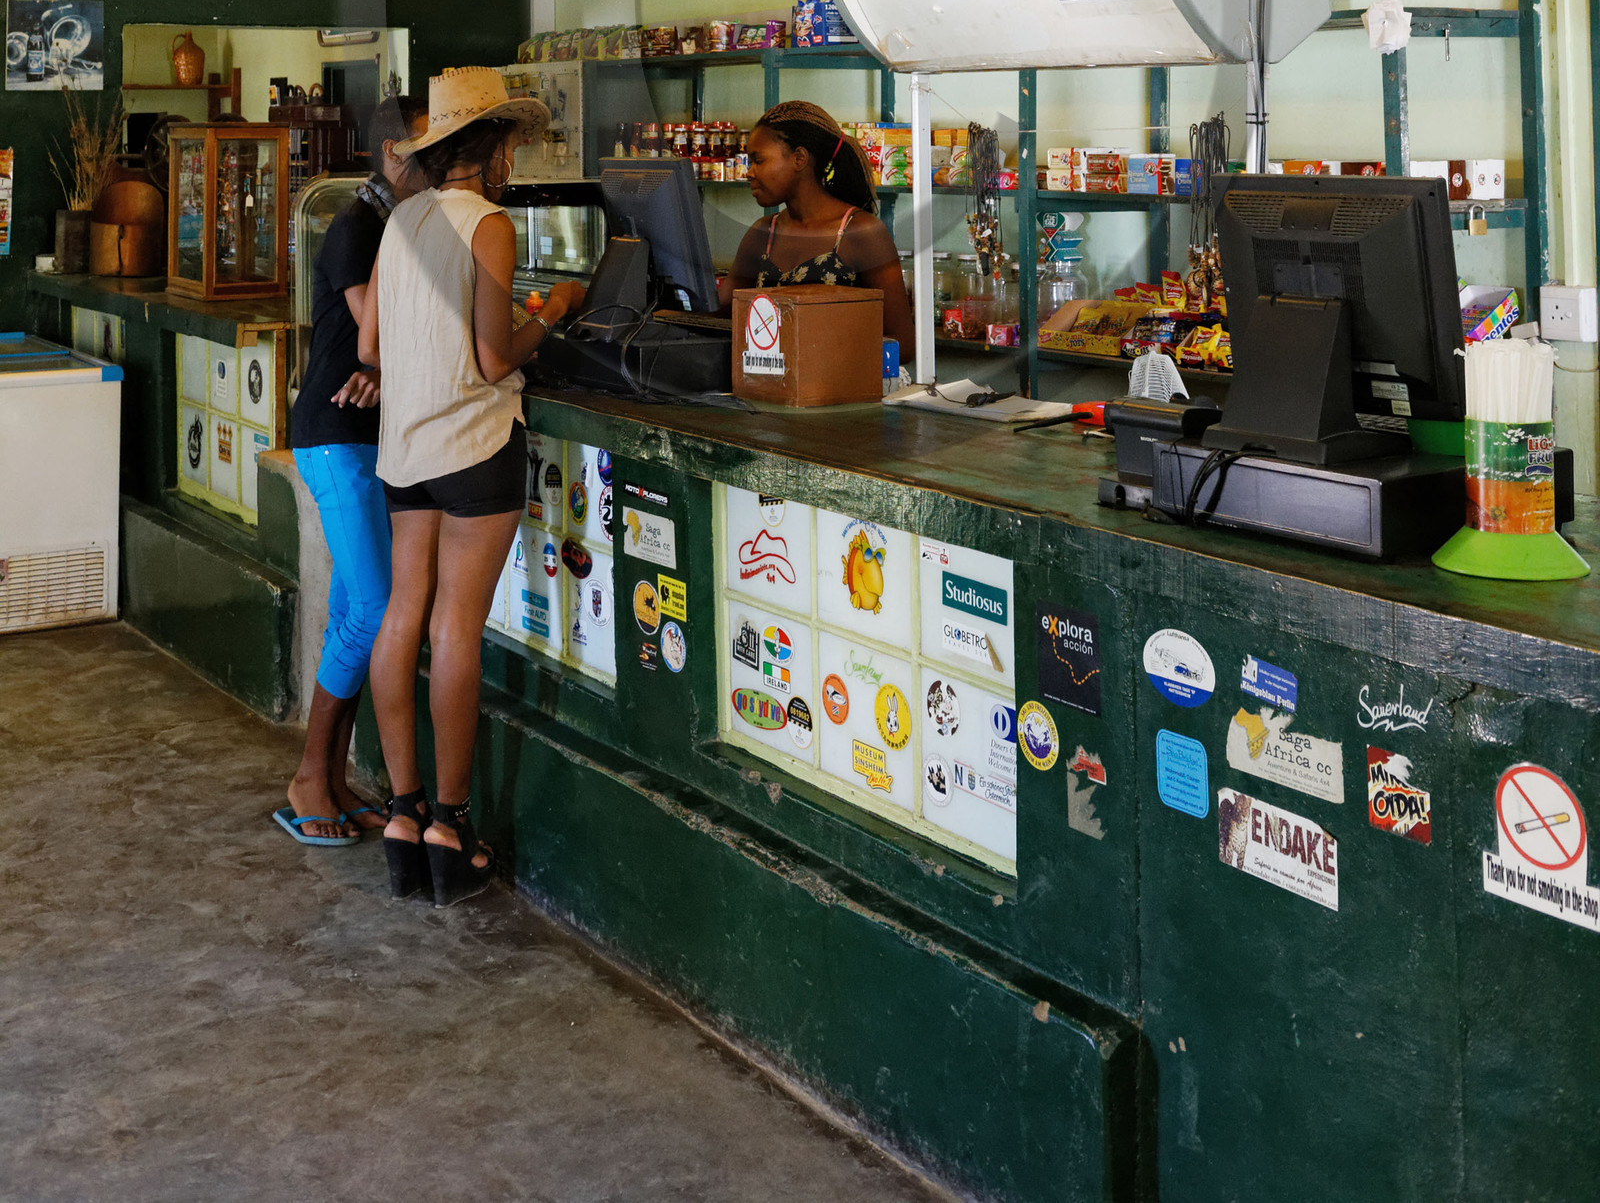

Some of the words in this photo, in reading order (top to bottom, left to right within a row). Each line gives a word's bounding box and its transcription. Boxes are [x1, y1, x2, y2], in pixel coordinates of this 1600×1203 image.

[646, 522, 662, 538] Saga
[640, 534, 661, 548] Africa
[662, 542, 670, 552] cc
[946, 580, 1003, 616] Studiosus
[1042, 615, 1093, 644] eXplora
[1166, 631, 1190, 642] Lufthansa
[1064, 639, 1094, 656] acción
[767, 676, 788, 691] IRELAND
[1357, 683, 1434, 730] Sauerland
[990, 738, 1008, 753] Diners
[1278, 727, 1312, 752] Saga
[855, 744, 884, 762] MUSEUM
[1265, 742, 1311, 768] Africa
[1316, 762, 1332, 776] cc
[855, 756, 884, 774] SINSHEIM
[988, 758, 1012, 774] Welcome
[954, 764, 963, 786] N
[1252, 808, 1335, 876] ENDAKE
[1307, 869, 1336, 887] EXPEDICIONES
[1487, 854, 1505, 884] Thank
[1506, 868, 1516, 892] you
[1518, 865, 1526, 892] for
[1527, 872, 1537, 897] not
[1538, 877, 1563, 913] smoking
[1564, 882, 1570, 908] in
[1572, 886, 1582, 913] the
[1584, 890, 1598, 926] shop
